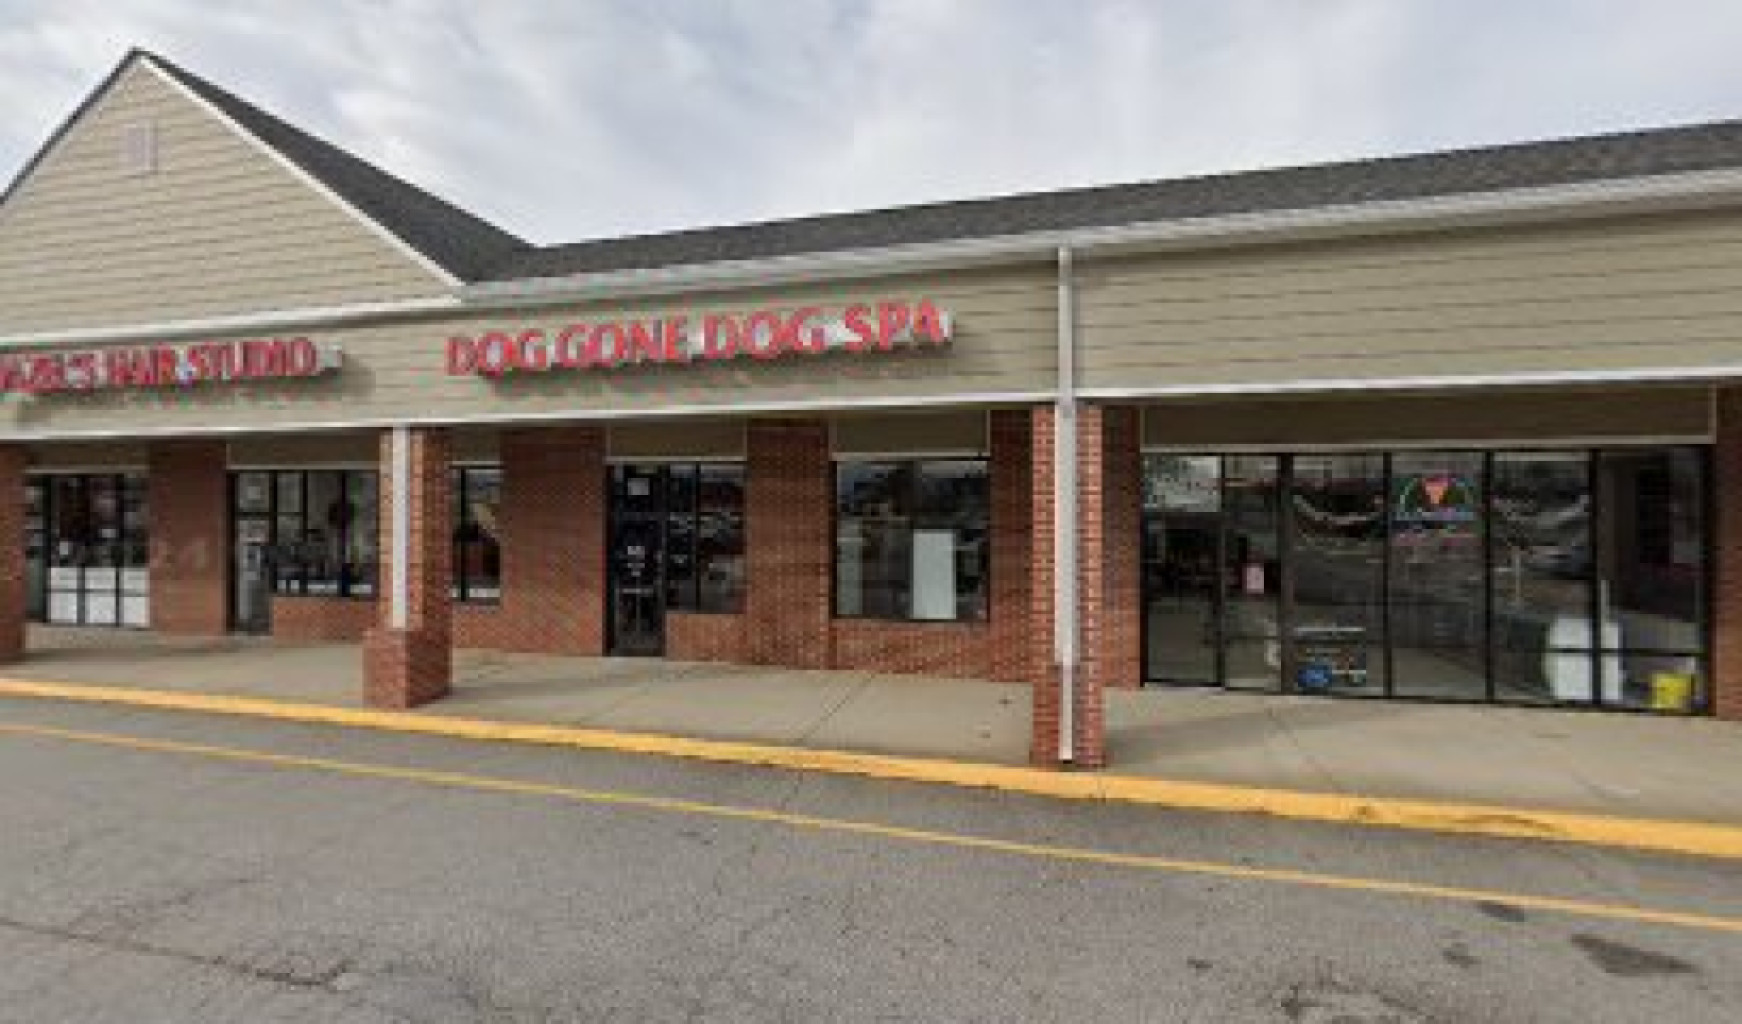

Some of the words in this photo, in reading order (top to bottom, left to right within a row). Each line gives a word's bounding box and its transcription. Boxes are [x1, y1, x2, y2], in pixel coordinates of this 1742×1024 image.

[444, 328, 548, 376] DOG
[556, 313, 690, 369] GONE
[702, 307, 825, 360] DOG
[843, 299, 948, 352] SPA
